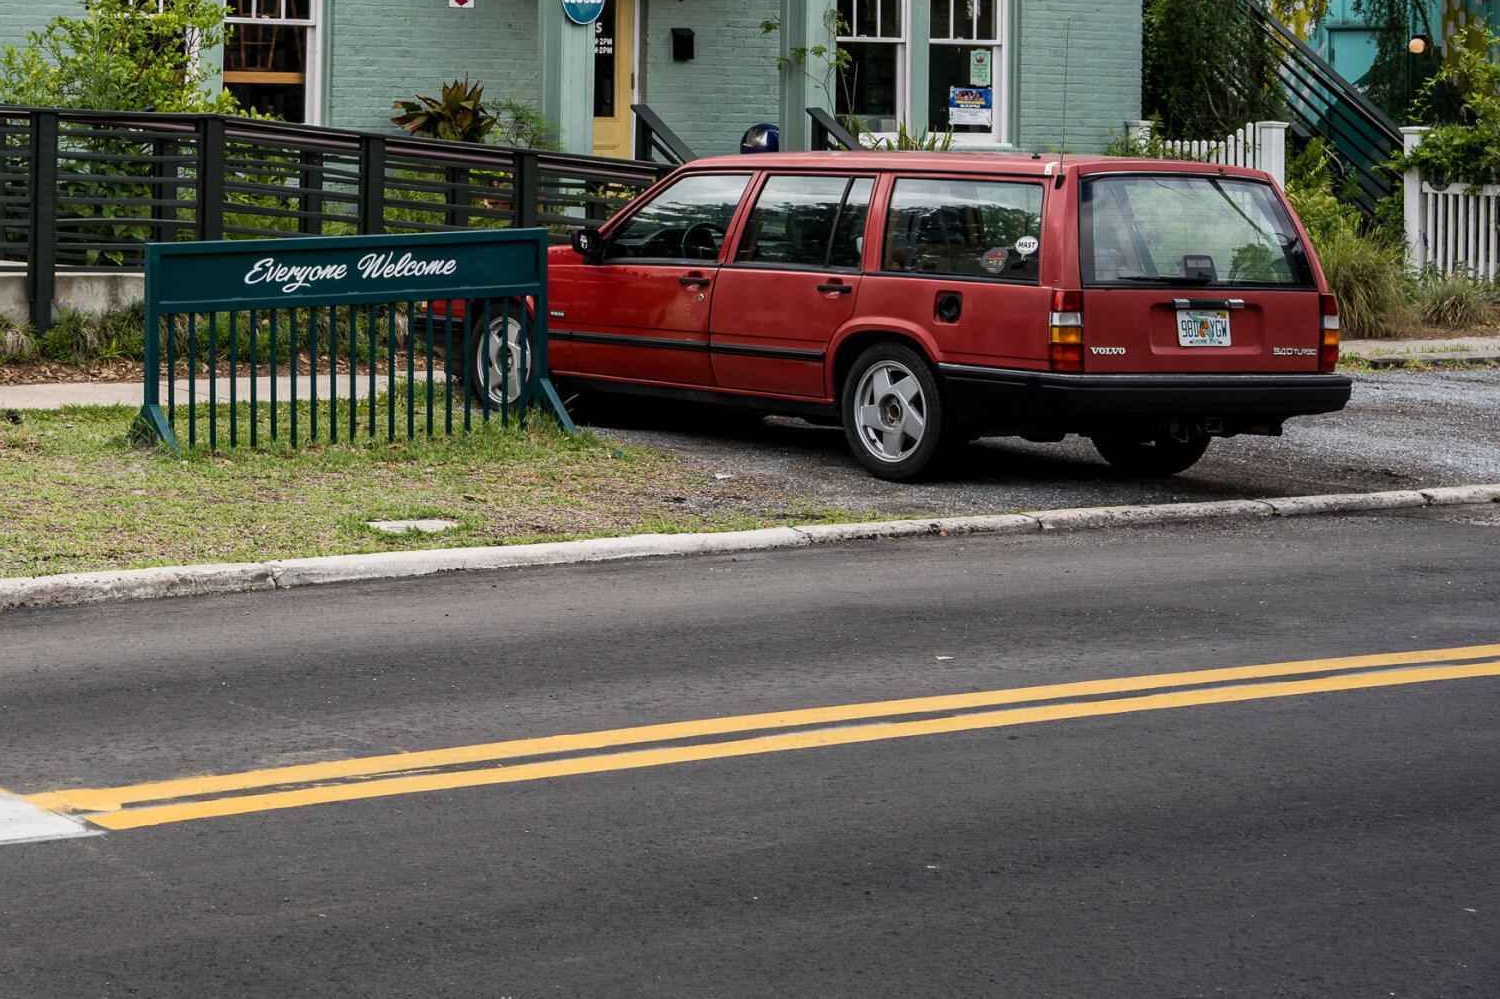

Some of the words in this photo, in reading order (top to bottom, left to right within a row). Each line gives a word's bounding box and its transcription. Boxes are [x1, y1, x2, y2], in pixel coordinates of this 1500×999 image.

[244, 257, 347, 293] Everyone
[357, 251, 457, 279] Welcome
[1090, 346, 1126, 355] VOLVO
